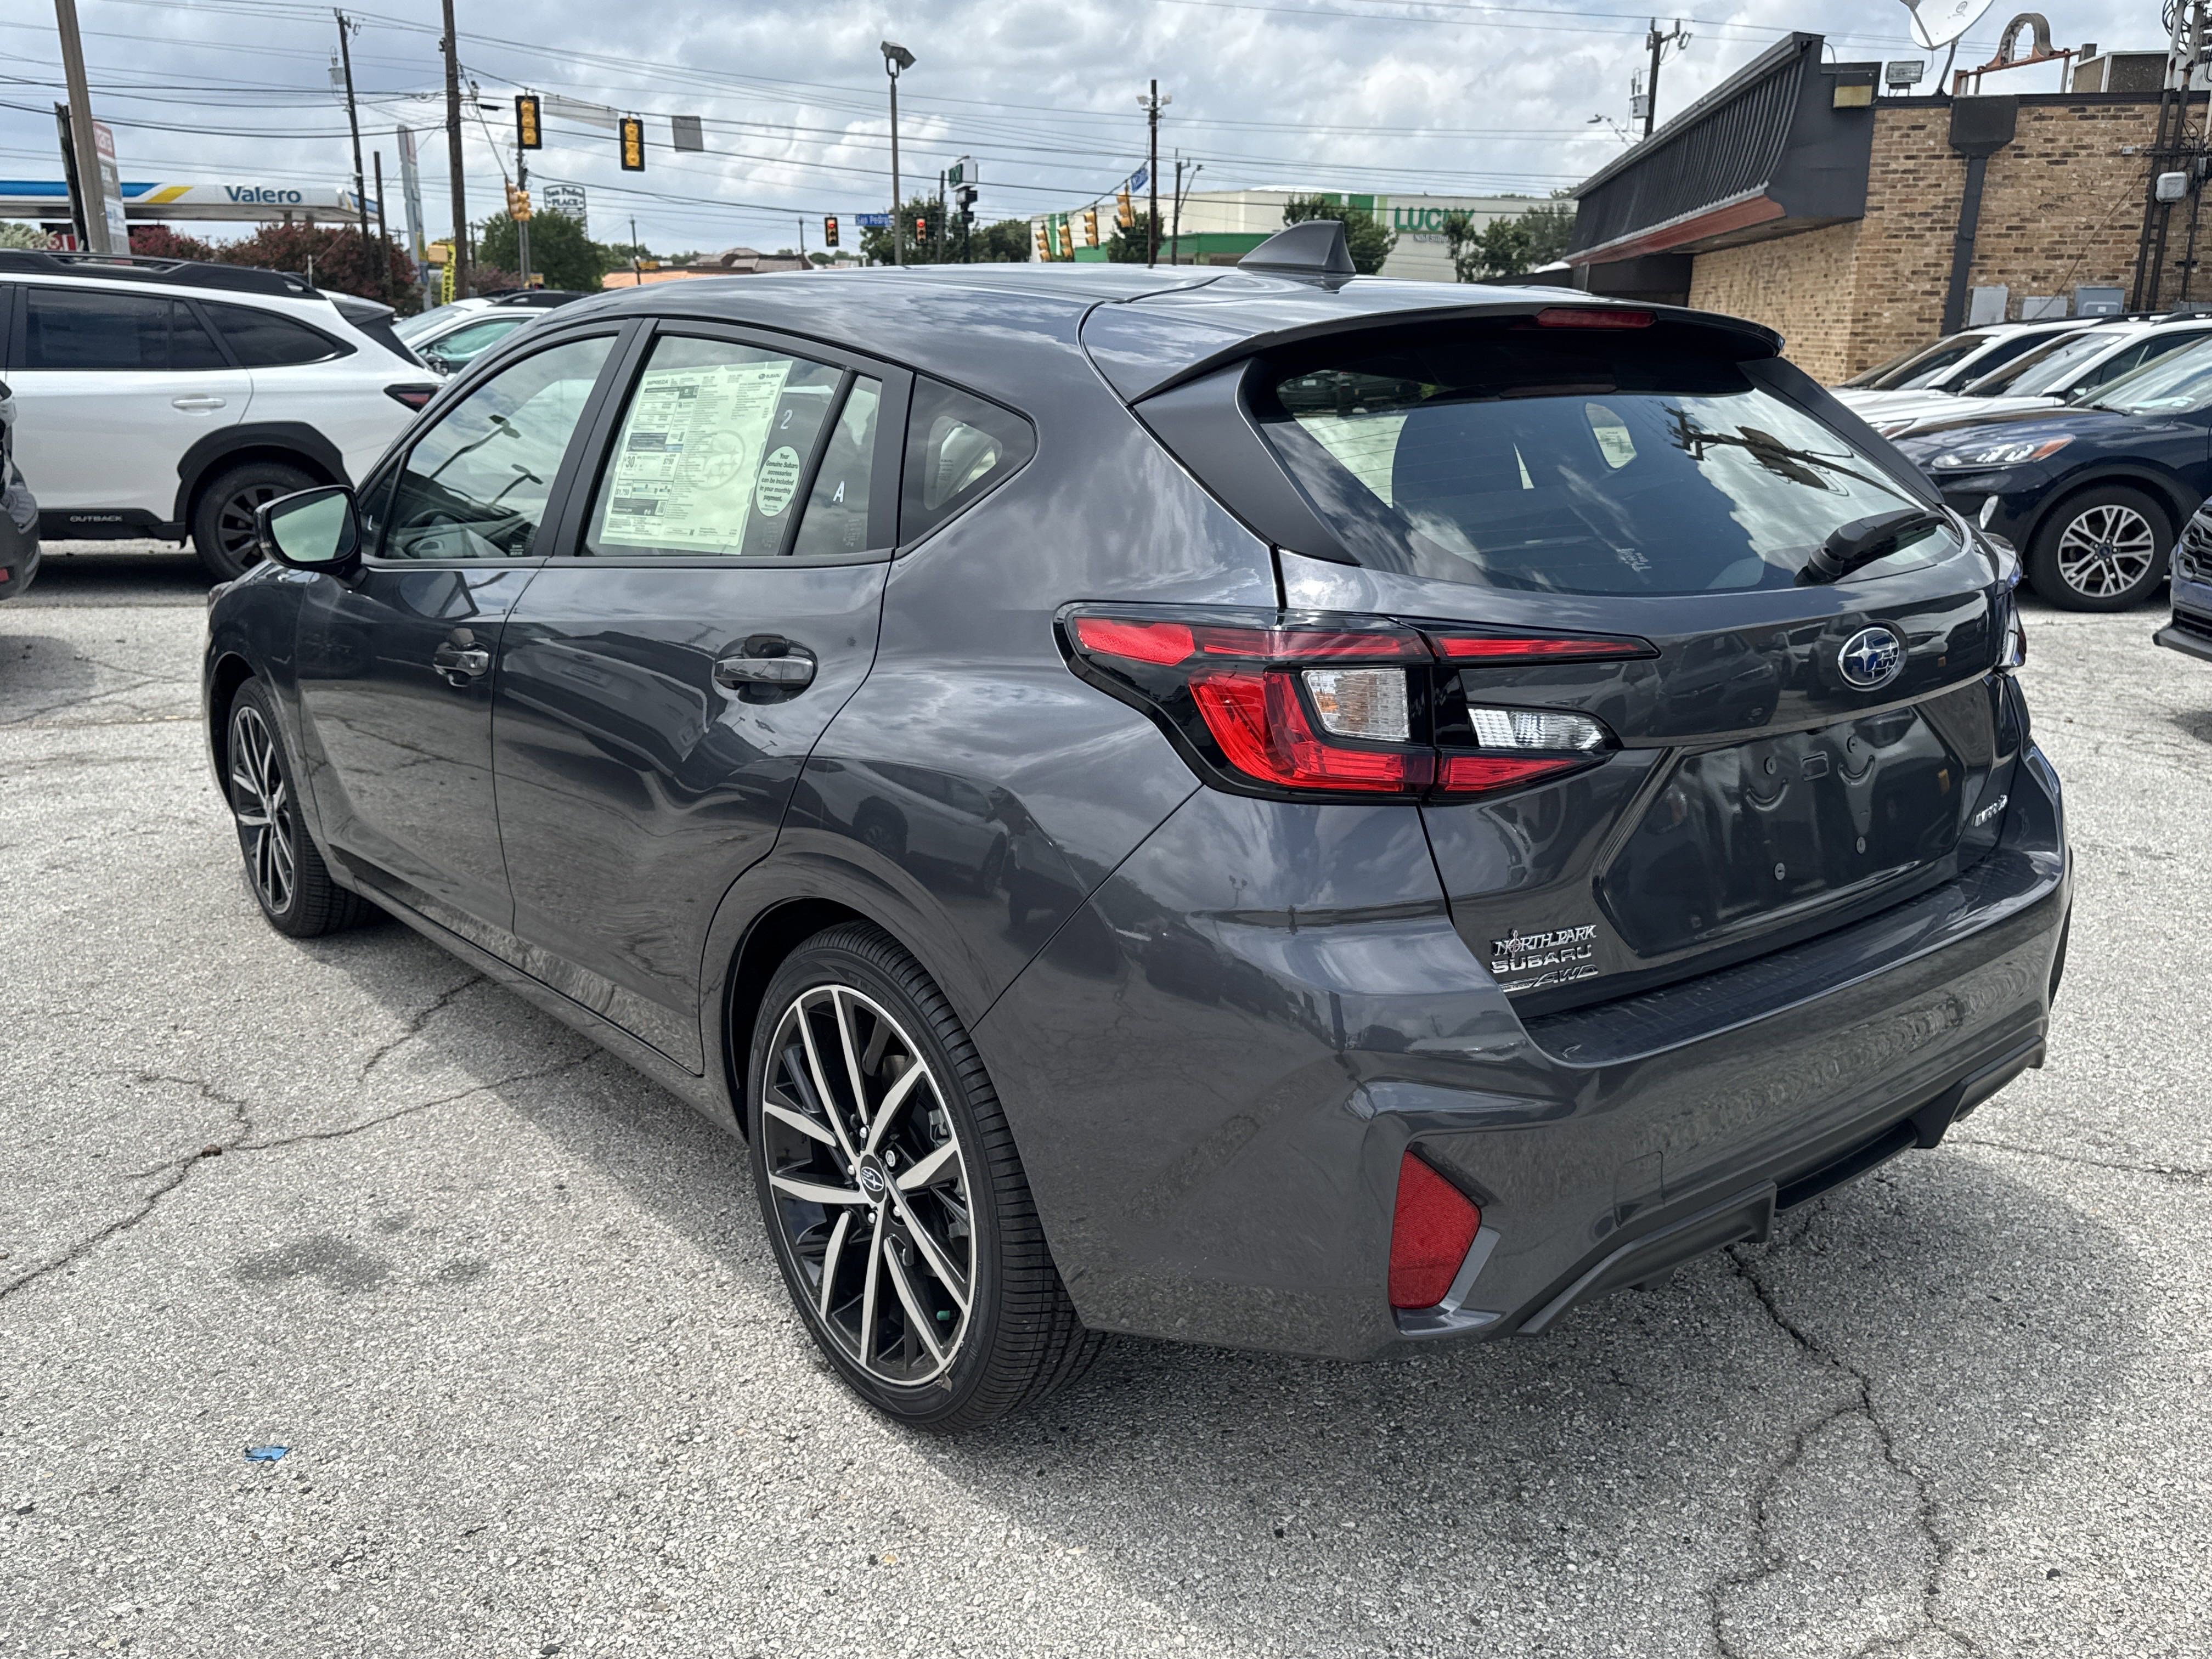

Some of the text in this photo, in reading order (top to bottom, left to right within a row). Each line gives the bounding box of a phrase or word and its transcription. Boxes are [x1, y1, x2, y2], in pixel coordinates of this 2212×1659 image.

[224, 185, 301, 204] Valero
[780, 409, 793, 430] 2
[774, 487, 792, 495] monthly
[833, 481, 845, 503] A
[1494, 924, 1598, 957] NORTH PARK
[1491, 944, 1592, 974] SUBARU
[1533, 964, 1599, 988] AWD
